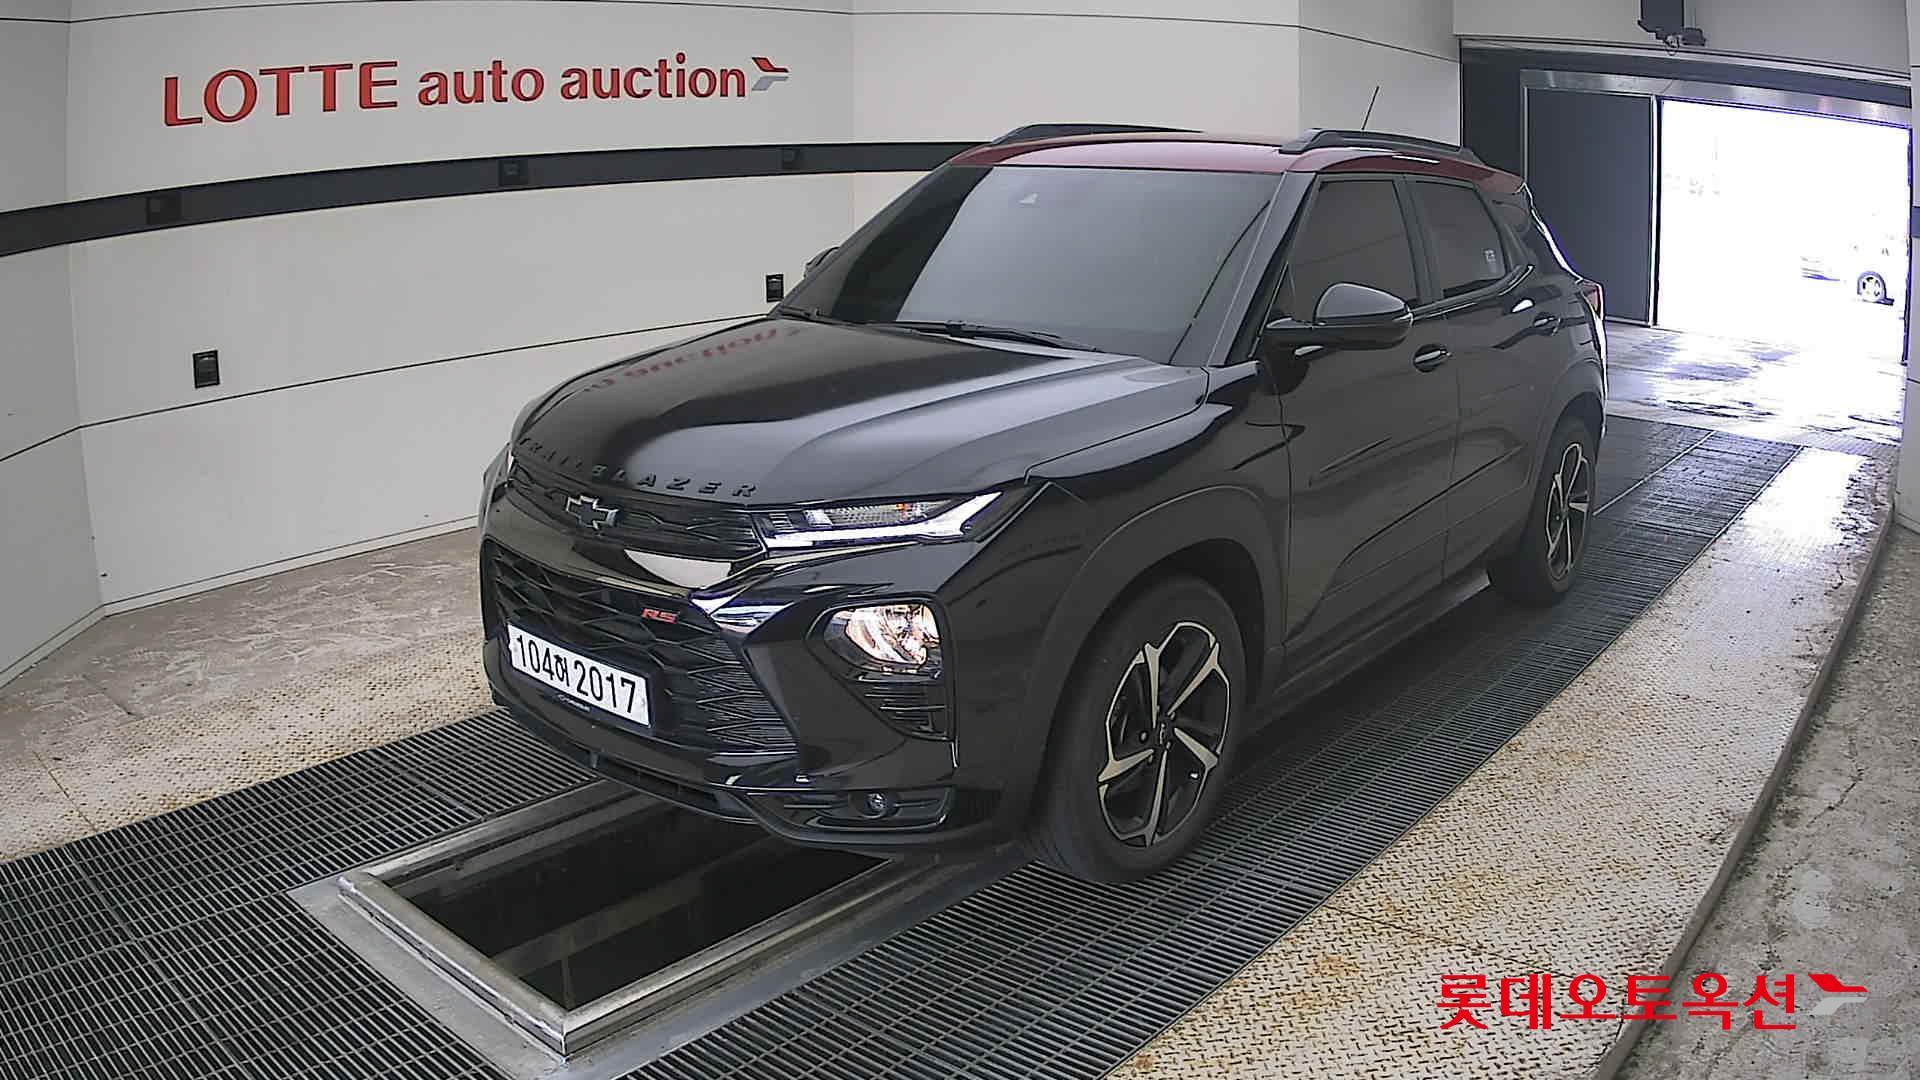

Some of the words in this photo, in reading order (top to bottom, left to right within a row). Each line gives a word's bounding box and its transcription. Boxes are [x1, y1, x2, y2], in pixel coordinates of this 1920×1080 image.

[163, 61, 398, 127] LOTTE
[418, 60, 545, 106] auto
[560, 52, 747, 100] auction
[641, 607, 681, 625] RS
